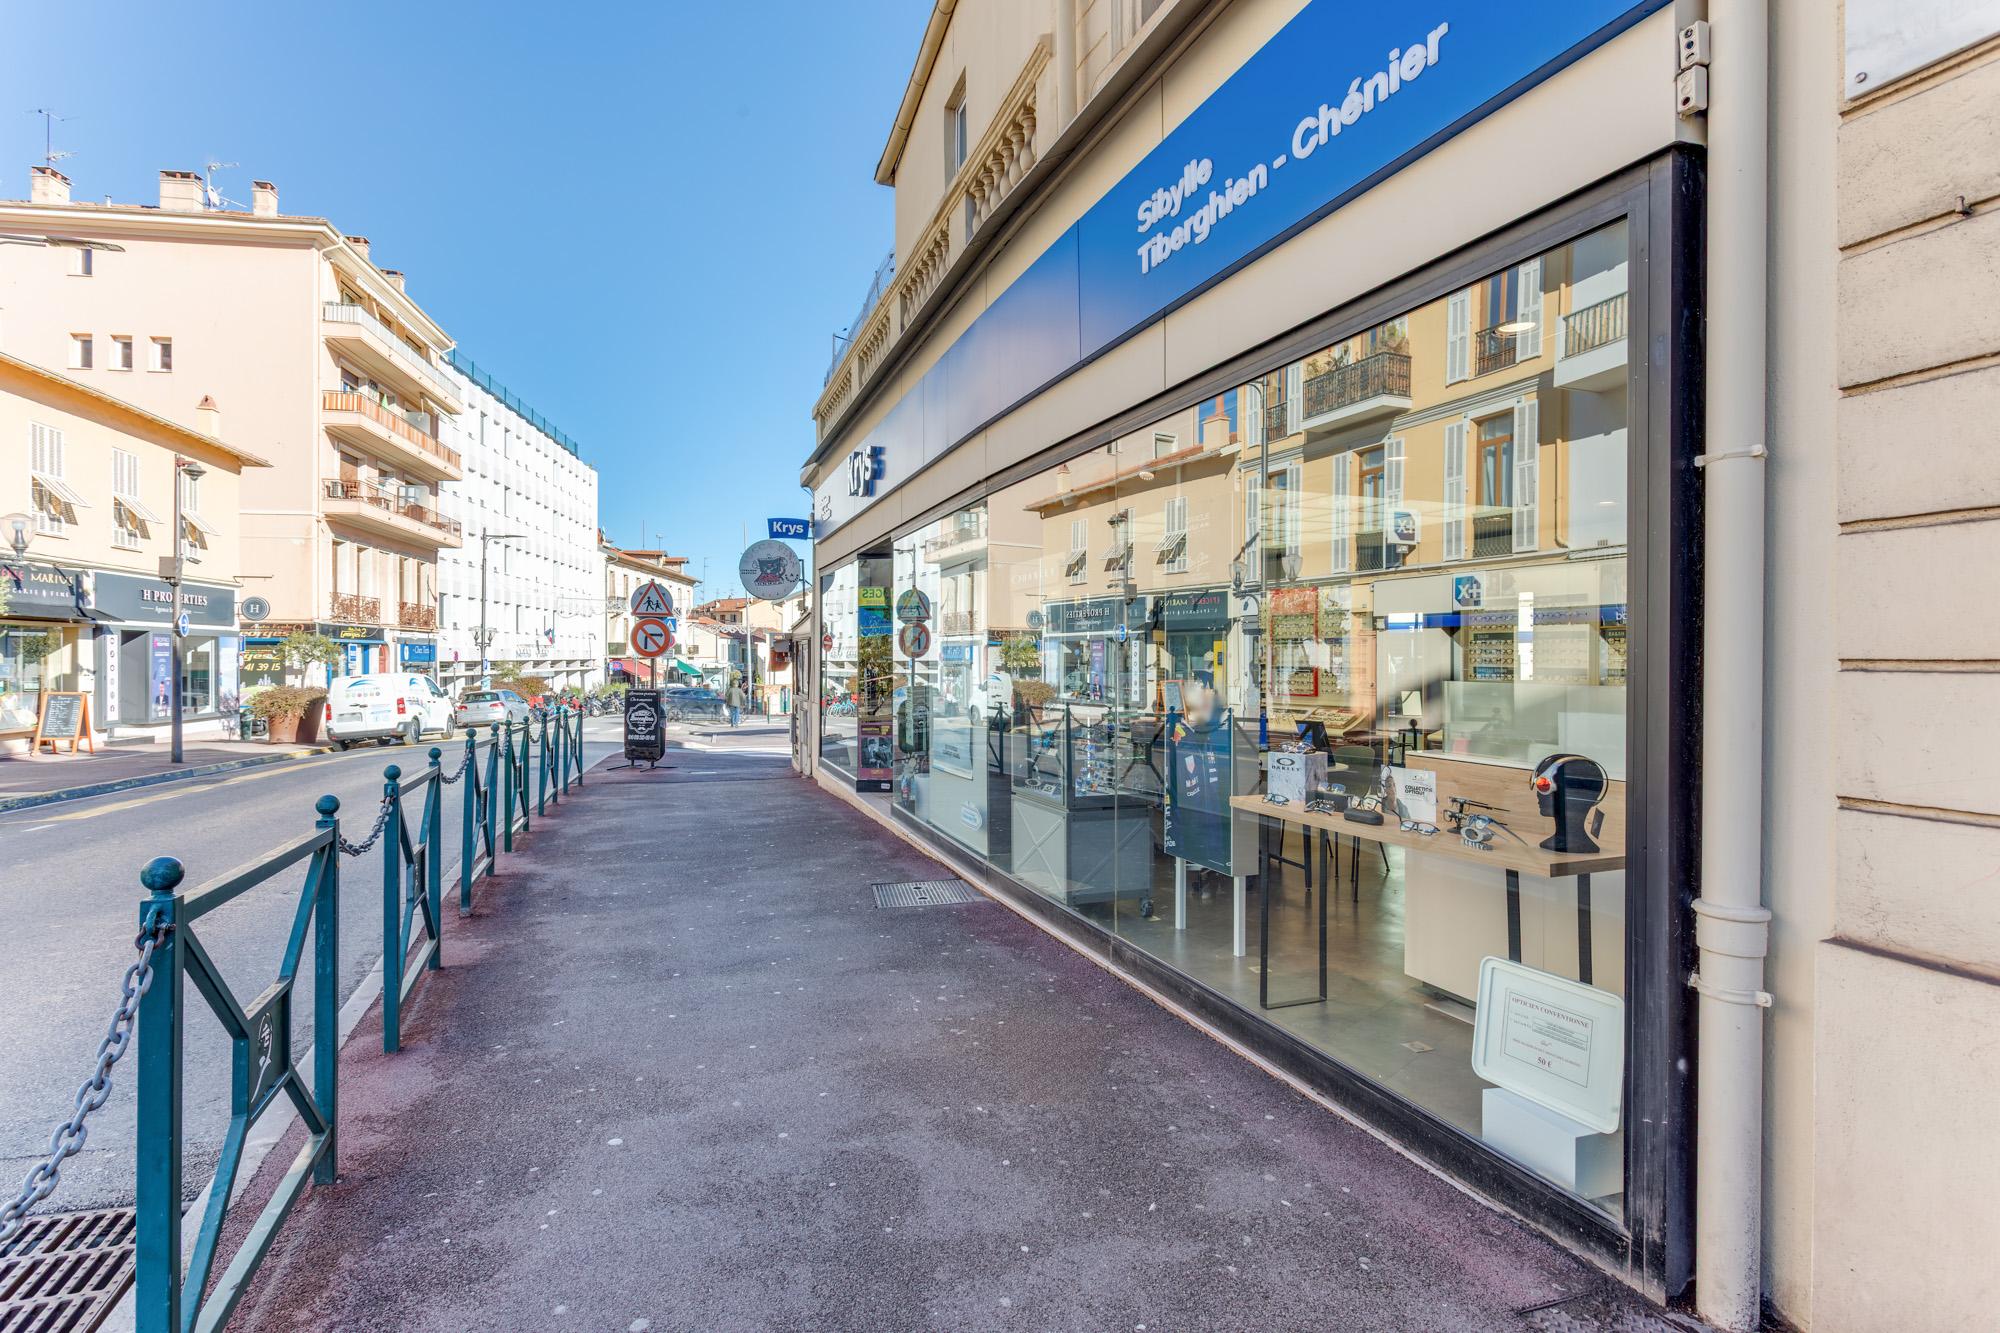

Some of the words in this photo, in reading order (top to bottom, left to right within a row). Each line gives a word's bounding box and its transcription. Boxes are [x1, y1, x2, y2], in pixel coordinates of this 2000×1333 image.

[1138, 163, 1268, 274] Tiberghien
[1292, 22, 1448, 159] Chénier
[1137, 157, 1213, 233] Sibylle
[847, 445, 880, 498] Krys
[772, 520, 805, 536] Krys
[143, 589, 151, 601] H
[153, 591, 208, 606] PROERTIES
[249, 604, 260, 613] H
[256, 663, 269, 671] 39
[271, 663, 281, 671] 15
[1512, 997, 1539, 1010] OPTICIEN
[1537, 1056, 1547, 1066] 50
